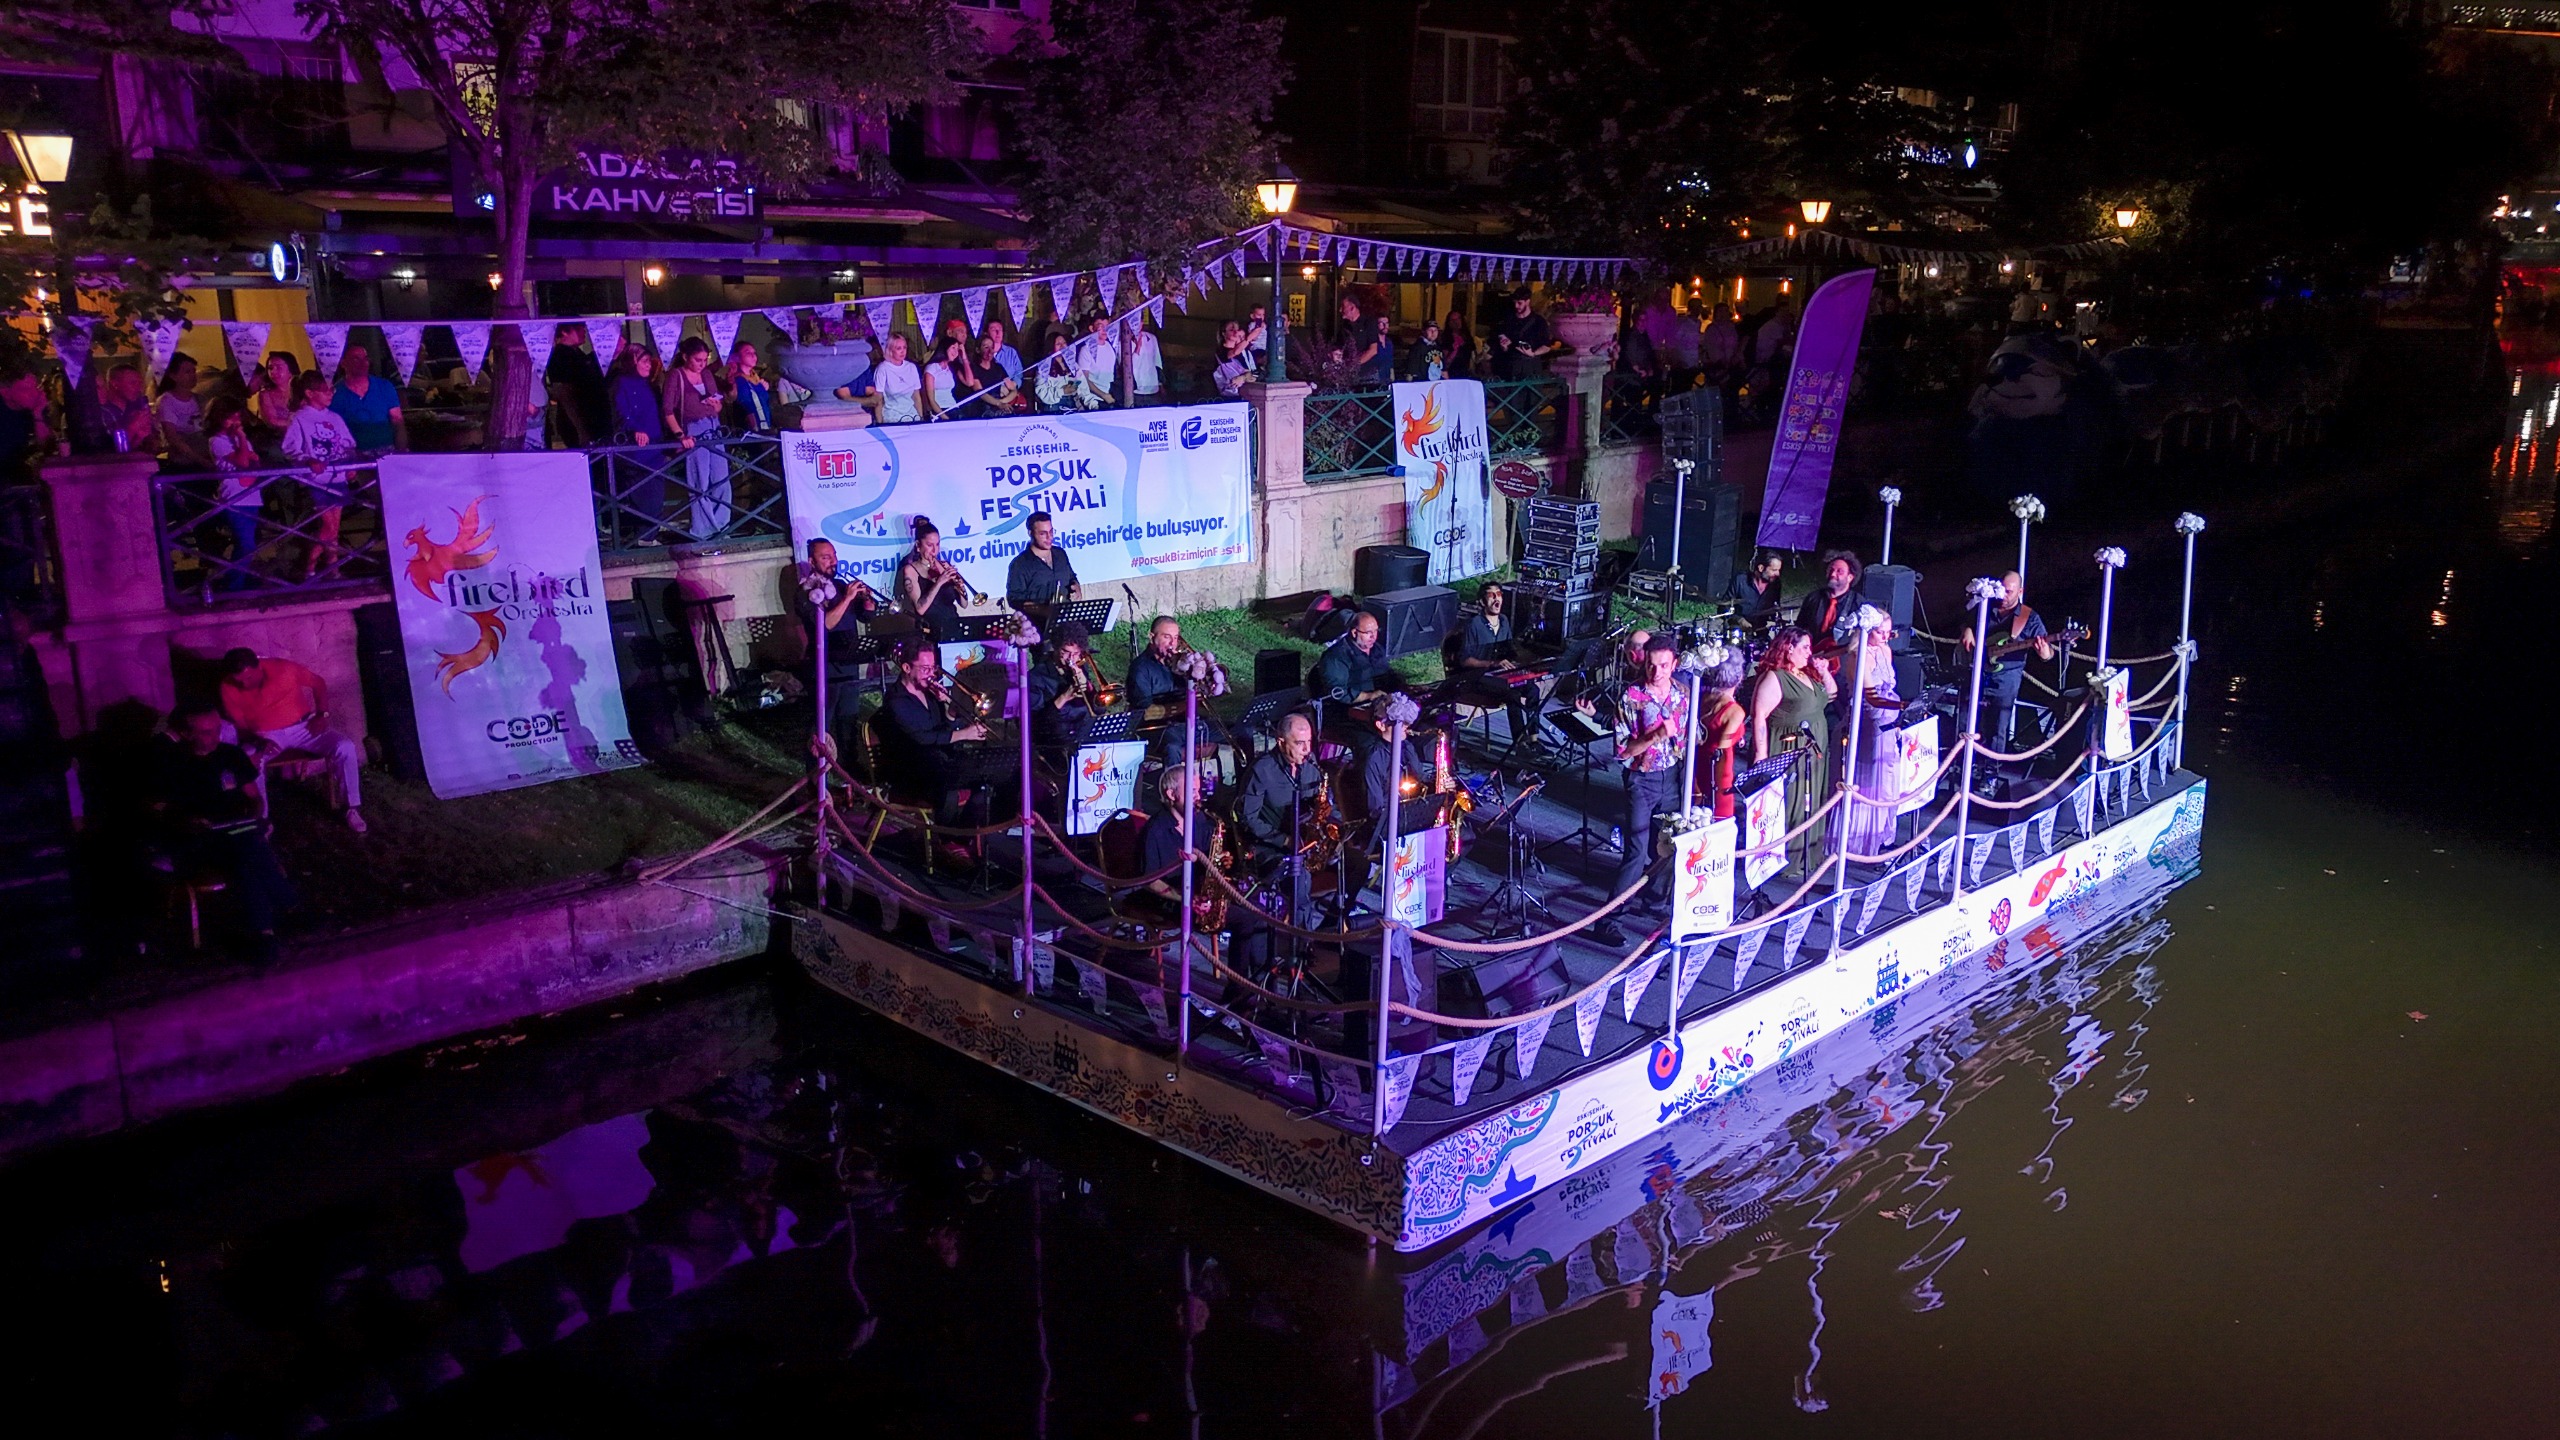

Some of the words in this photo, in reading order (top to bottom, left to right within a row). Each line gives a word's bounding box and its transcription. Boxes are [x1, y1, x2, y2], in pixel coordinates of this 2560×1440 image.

[1018, 424, 1058, 442] ULUSLARARASI
[1149, 421, 1167, 432] AYŞE
[1139, 431, 1168, 443] ÜNLÜCE
[1782, 441, 1816, 451] ESKİŞHİR
[985, 458, 1097, 488] PORSUK
[1053, 523, 1143, 549] skişehir'de
[1146, 515, 1229, 539] buluşuyor.
[1434, 525, 1466, 546] CODE
[445, 562, 590, 607] firebird
[503, 602, 594, 622] Orchestra
[486, 711, 570, 742] CODE
[505, 736, 558, 748] PRODUCTION
[1692, 904, 1720, 915] CODE
[1566, 1109, 1616, 1143] PORSUK
